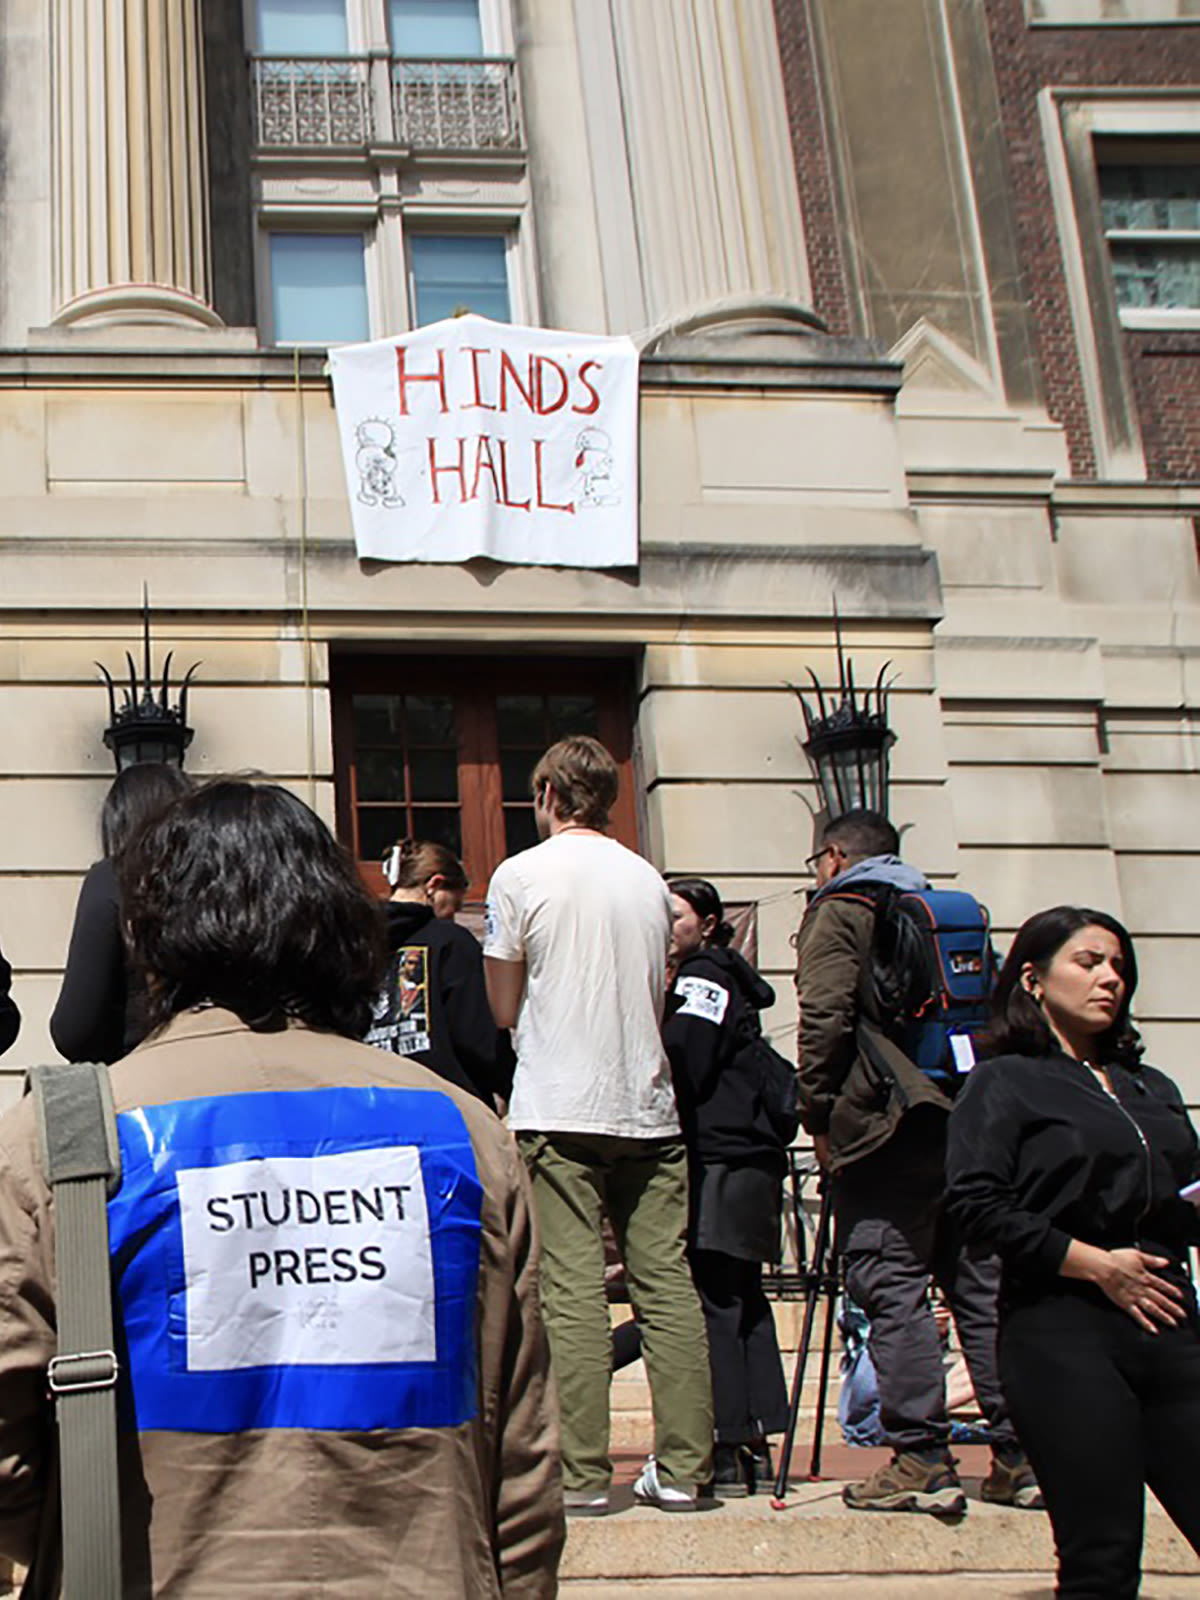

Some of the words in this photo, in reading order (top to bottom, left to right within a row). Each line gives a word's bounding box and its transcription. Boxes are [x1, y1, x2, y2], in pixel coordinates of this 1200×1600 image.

[426, 436, 575, 514] HALL
[207, 1185, 411, 1232] STUDENT
[249, 1246, 386, 1289] PRESS
